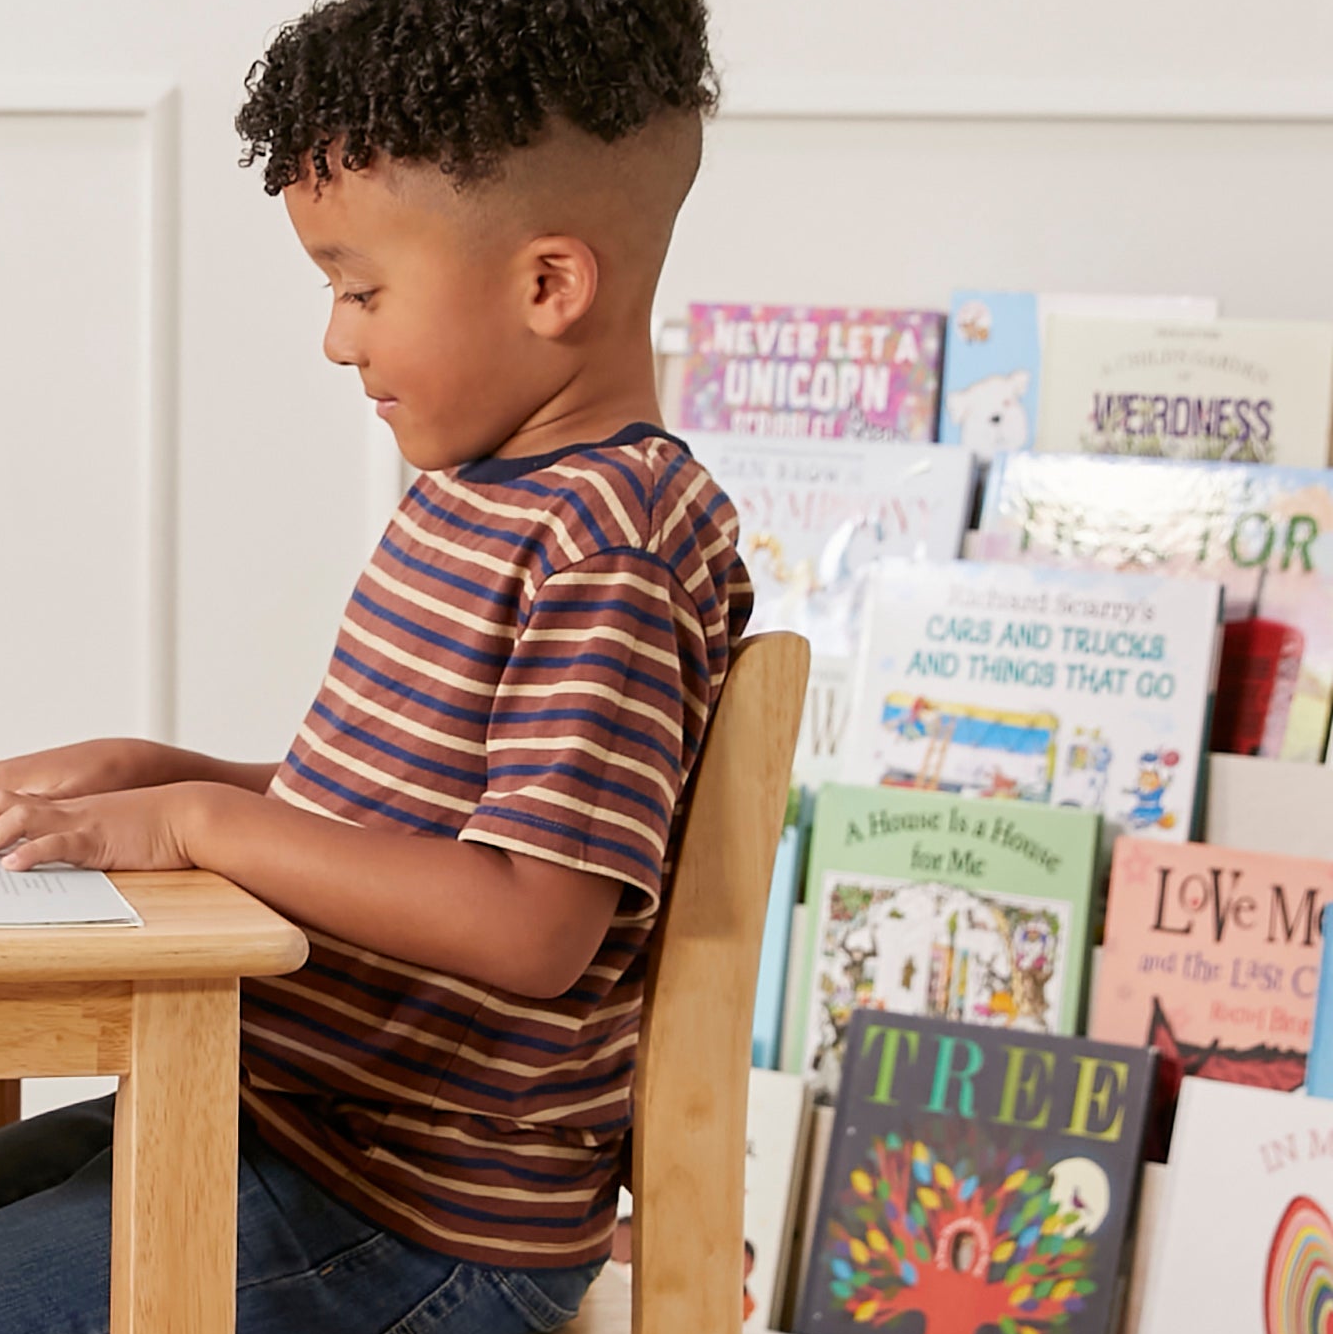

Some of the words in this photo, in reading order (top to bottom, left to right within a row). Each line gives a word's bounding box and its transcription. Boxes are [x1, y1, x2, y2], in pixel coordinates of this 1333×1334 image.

[713, 320, 818, 358] NEVER
[829, 322, 891, 361] LET
[894, 328, 919, 364] A
[723, 360, 890, 413] UNICORN
[1056, 592, 1157, 624] Scarry's
[927, 616, 993, 643] CARS
[997, 622, 1053, 650] AND
[1061, 627, 1166, 660] TRUCKS
[905, 651, 960, 679] AND
[968, 655, 1056, 688] THINGS
[1066, 664, 1129, 694] THAT
[1135, 673, 1176, 701] GO
[844, 820, 864, 846] A
[867, 810, 942, 838] House
[972, 820, 987, 838] a
[990, 817, 1064, 874] House
[910, 841, 943, 870] for
[946, 848, 986, 877] Me
[1138, 951, 1178, 974] and
[1182, 952, 1220, 983] the
[860, 1023, 1130, 1144] TREE
